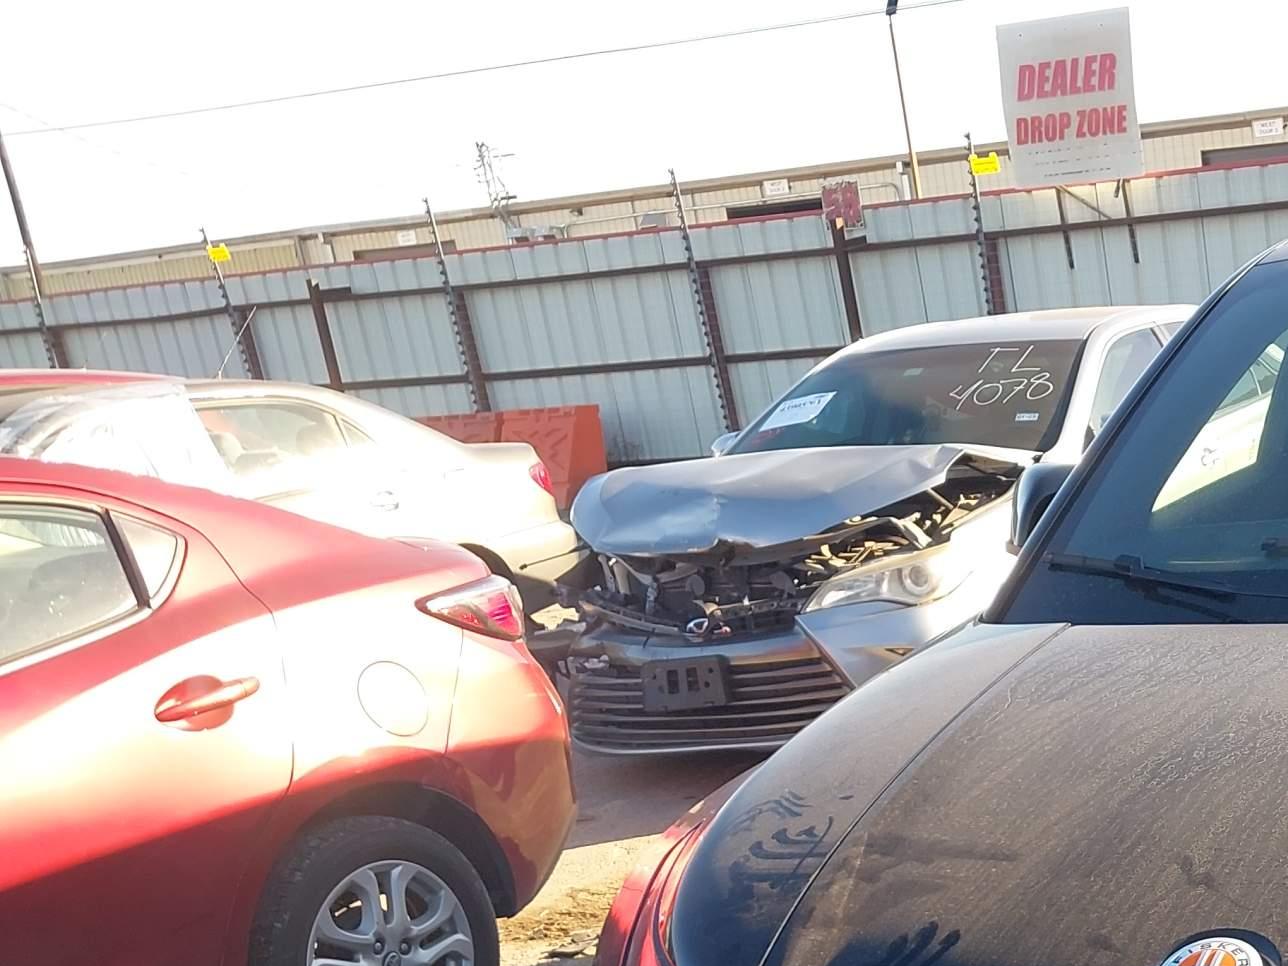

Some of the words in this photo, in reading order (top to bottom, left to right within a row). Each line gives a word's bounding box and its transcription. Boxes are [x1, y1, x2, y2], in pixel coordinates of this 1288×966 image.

[1016, 53, 1117, 102] DEALER
[1016, 112, 1071, 146] DROP
[1076, 104, 1128, 139] ZONE
[949, 371, 1053, 411] 4078
[1172, 942, 1249, 966] FISKER
